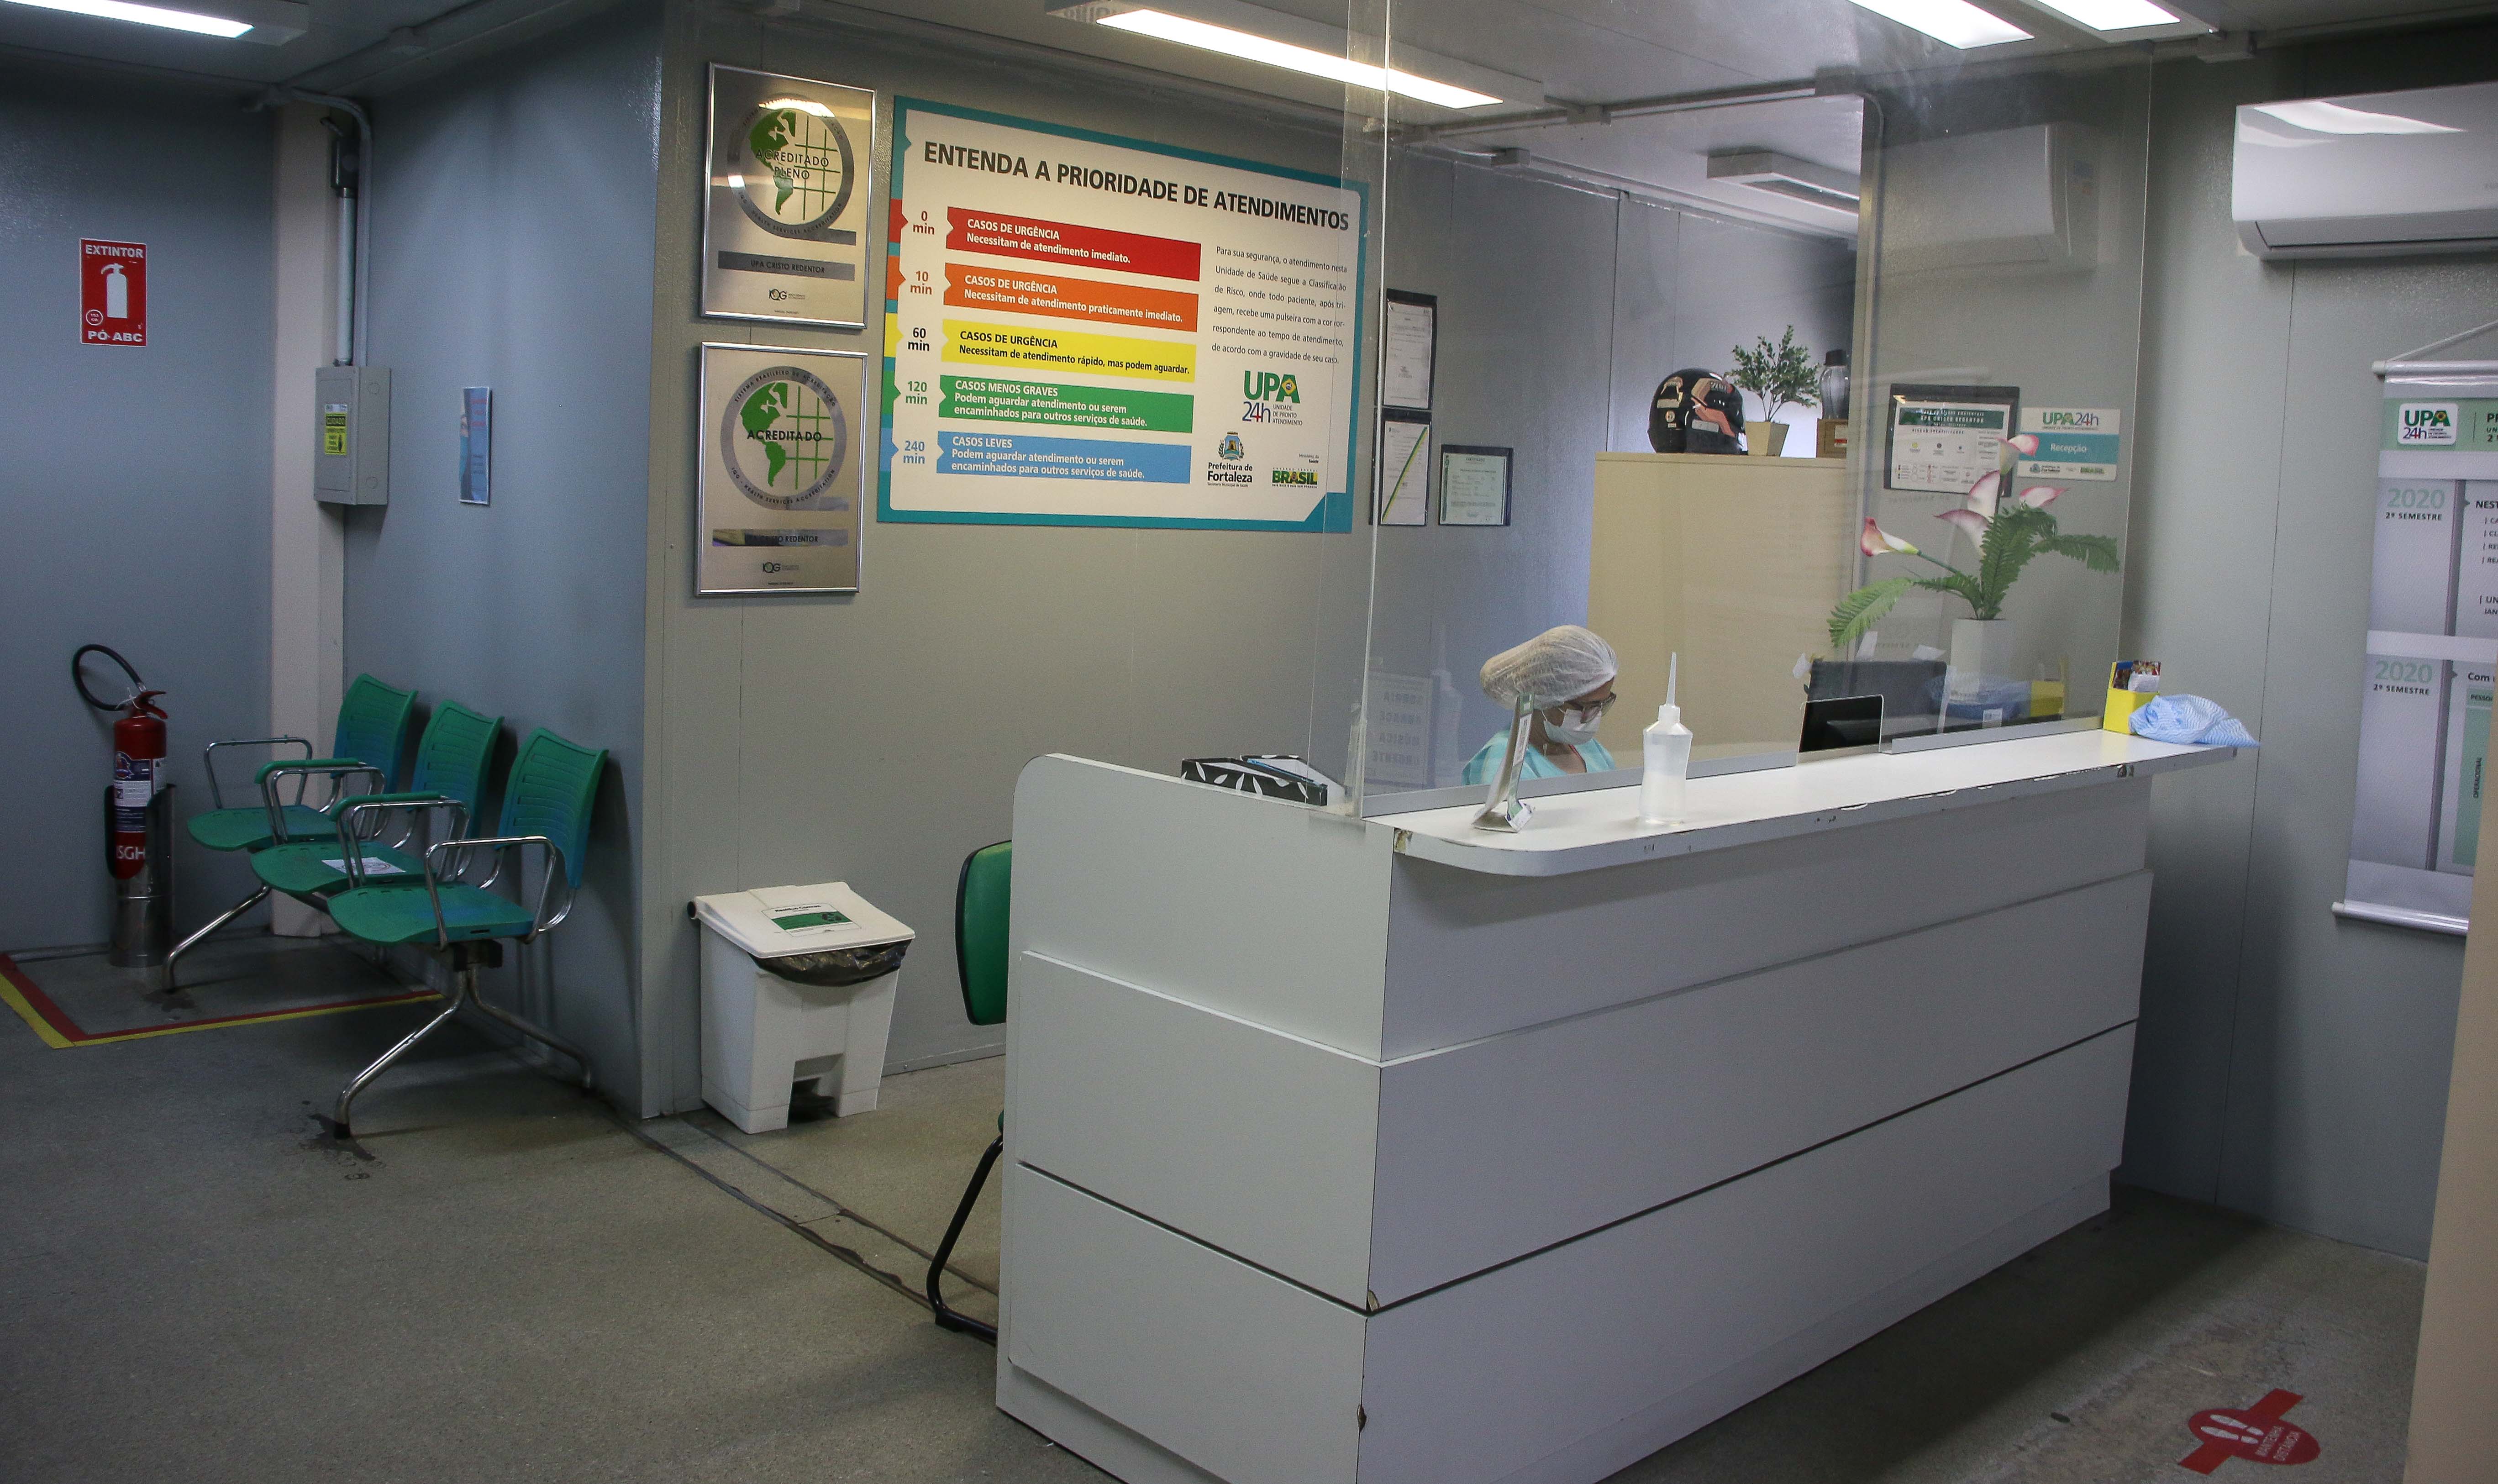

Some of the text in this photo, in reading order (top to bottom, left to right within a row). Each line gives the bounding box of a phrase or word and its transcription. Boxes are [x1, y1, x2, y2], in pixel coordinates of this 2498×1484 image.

[756, 148, 829, 167] ACREDITADO
[774, 166, 810, 180] PLENO
[925, 141, 1349, 231] ENTENDA A PRIORIDADE DE ATENDIMENTOS
[921, 210, 928, 221] 0
[913, 223, 935, 235] min
[968, 218, 1060, 241] CASOS DE URGÊNCIA
[85, 244, 143, 258] EXTINTOR
[967, 232, 1131, 263] Necessitam de atendimento imediato.
[751, 259, 825, 273] UPA CRISTO REDENTOR
[1216, 246, 1232, 256] Para
[1246, 252, 1281, 264] segurança,
[1289, 258, 1330, 271] atendimento
[1331, 265, 1347, 273] nesta
[916, 271, 929, 282] 10
[1215, 265, 1244, 277] Unidade
[1247, 270, 1256, 279] de
[1258, 271, 1278, 281] Saúde
[1280, 276, 1300, 286] segue
[910, 283, 932, 295] min
[965, 274, 1057, 295] CASOS DE URGÊNCIA
[769, 289, 788, 301] IQG
[1215, 284, 1224, 294] de
[1226, 286, 1246, 297] Risco,
[1248, 289, 1266, 299] onde
[1269, 293, 1285, 301] todo
[1288, 295, 1316, 307] paciente,
[1320, 299, 1334, 309] após
[964, 289, 1183, 322] Necessitam de atendimento praticamente imediato.
[1213, 305, 1235, 316] agem,
[1236, 309, 1259, 317] recebe
[1276, 312, 1302, 323] pulseira
[112, 332, 143, 342] ABC
[913, 327, 926, 339] 60
[960, 330, 1058, 348] CASOS DE URGÊNCIA
[1213, 325, 1256, 336] respondente
[1269, 331, 1290, 342] tempo
[1292, 332, 1301, 341] de
[908, 339, 930, 352] min
[1212, 343, 1220, 352] de
[1222, 346, 1246, 354] acordo
[1269, 351, 1301, 359] gravidade
[1303, 353, 1311, 362] de
[959, 344, 1189, 376] Necessitam de atendimento rápido, mas podem aguardar.
[907, 381, 927, 393] 120
[955, 380, 1058, 397] CASOS MENOS GRAVES
[1244, 370, 1300, 403] UPA
[905, 393, 927, 405] min
[954, 393, 1127, 414] Podem aguardar atendimento ou serem
[954, 405, 1147, 427] encaminhados para outros serviços de saúde.
[1242, 401, 1271, 423] 24h
[2404, 410, 2451, 426] UPA
[747, 430, 822, 442] ACREDITADO
[2403, 427, 2427, 439] 24h
[904, 440, 925, 452] 240
[952, 436, 1013, 449] CASOS LEVES
[2050, 443, 2087, 453] Recepção
[903, 452, 926, 465] min
[952, 448, 1124, 466] Podem aguardar atendimento ou serem
[951, 461, 1145, 479] encaminhados para outros serviços de saúde.
[1208, 462, 1242, 471] Prefeitura
[1208, 471, 1252, 483] Fortaleza
[1272, 470, 1317, 484] BRASIL
[2388, 489, 2445, 509] 2020
[2398, 512, 2443, 521] SEMESTRE
[763, 562, 781, 573] IQG
[2374, 660, 2433, 684] 2020
[2467, 672, 2490, 682] Com
[2386, 685, 2430, 695] SEMESTRE
